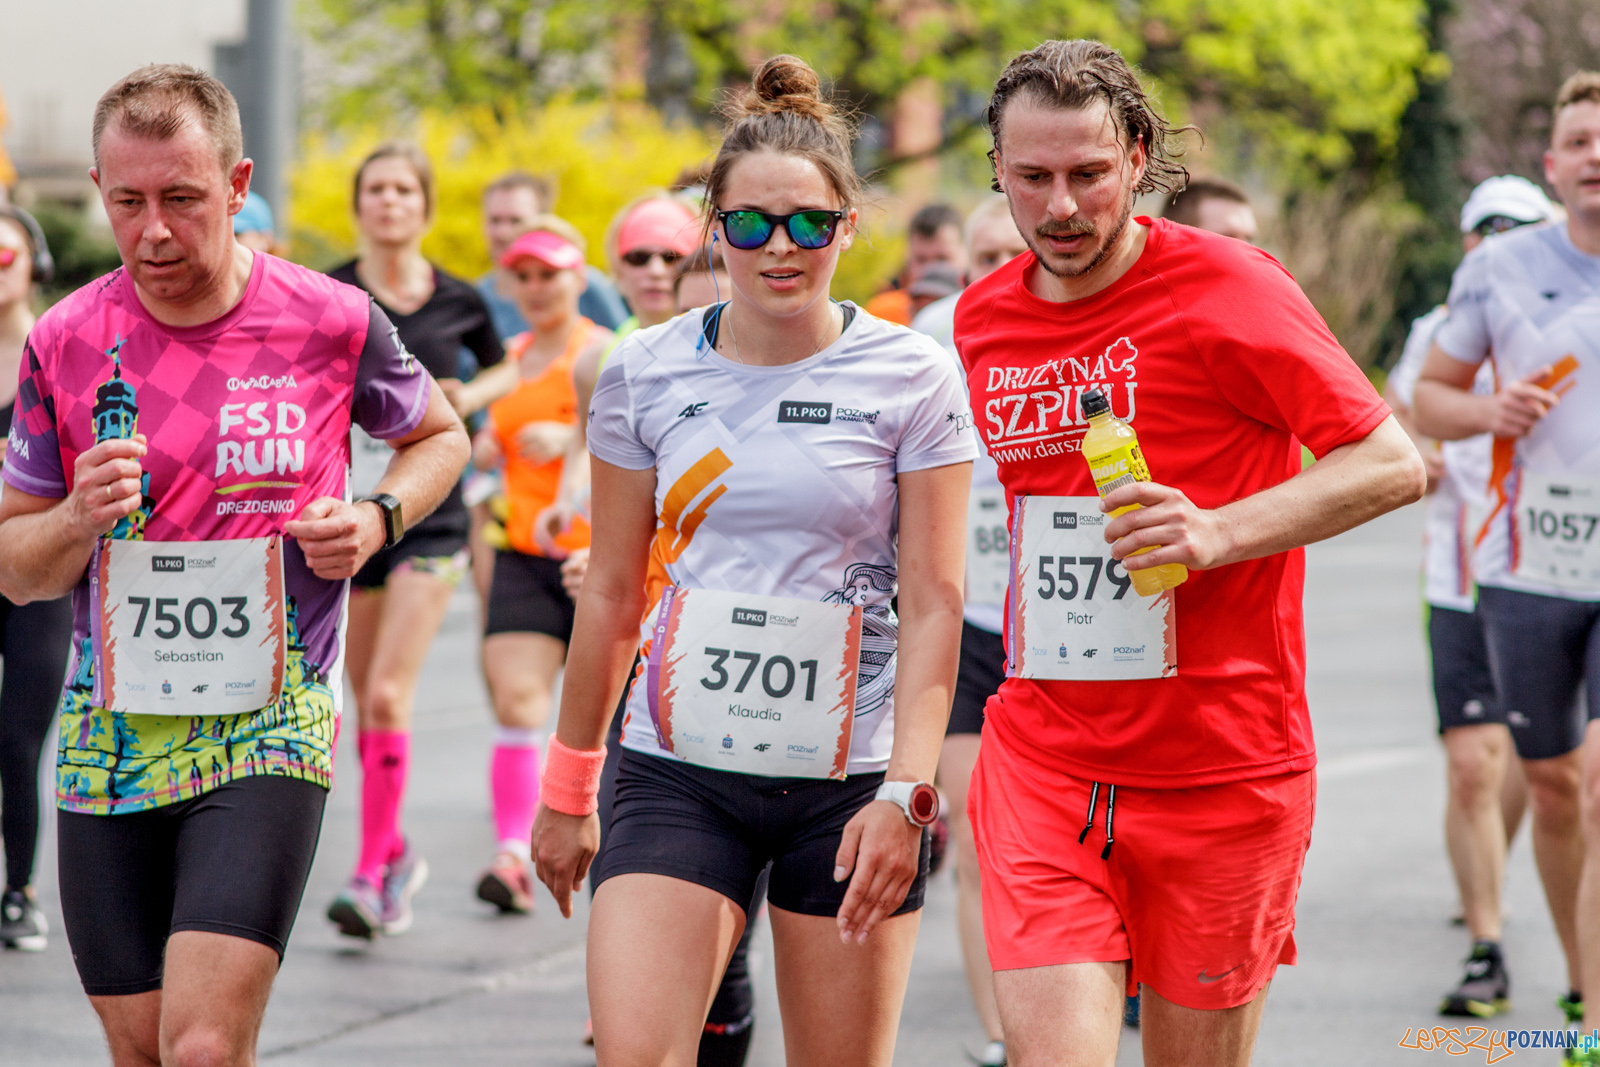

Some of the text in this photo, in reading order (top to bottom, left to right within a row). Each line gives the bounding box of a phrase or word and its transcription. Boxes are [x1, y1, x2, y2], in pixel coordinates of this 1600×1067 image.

[986, 355, 1106, 392] DRUŻYNA
[219, 401, 306, 437] FSD
[214, 438, 305, 478] RUN
[992, 438, 1084, 464] www.darsz
[216, 499, 295, 516] DREZDENKO
[1527, 507, 1598, 542] 1057
[1038, 555, 1132, 600] 5579
[128, 596, 250, 640] 7503
[1067, 612, 1093, 625] Piotr
[154, 650, 224, 663] Sebastian
[700, 647, 818, 701] 3701
[728, 704, 782, 722] Klaudia
